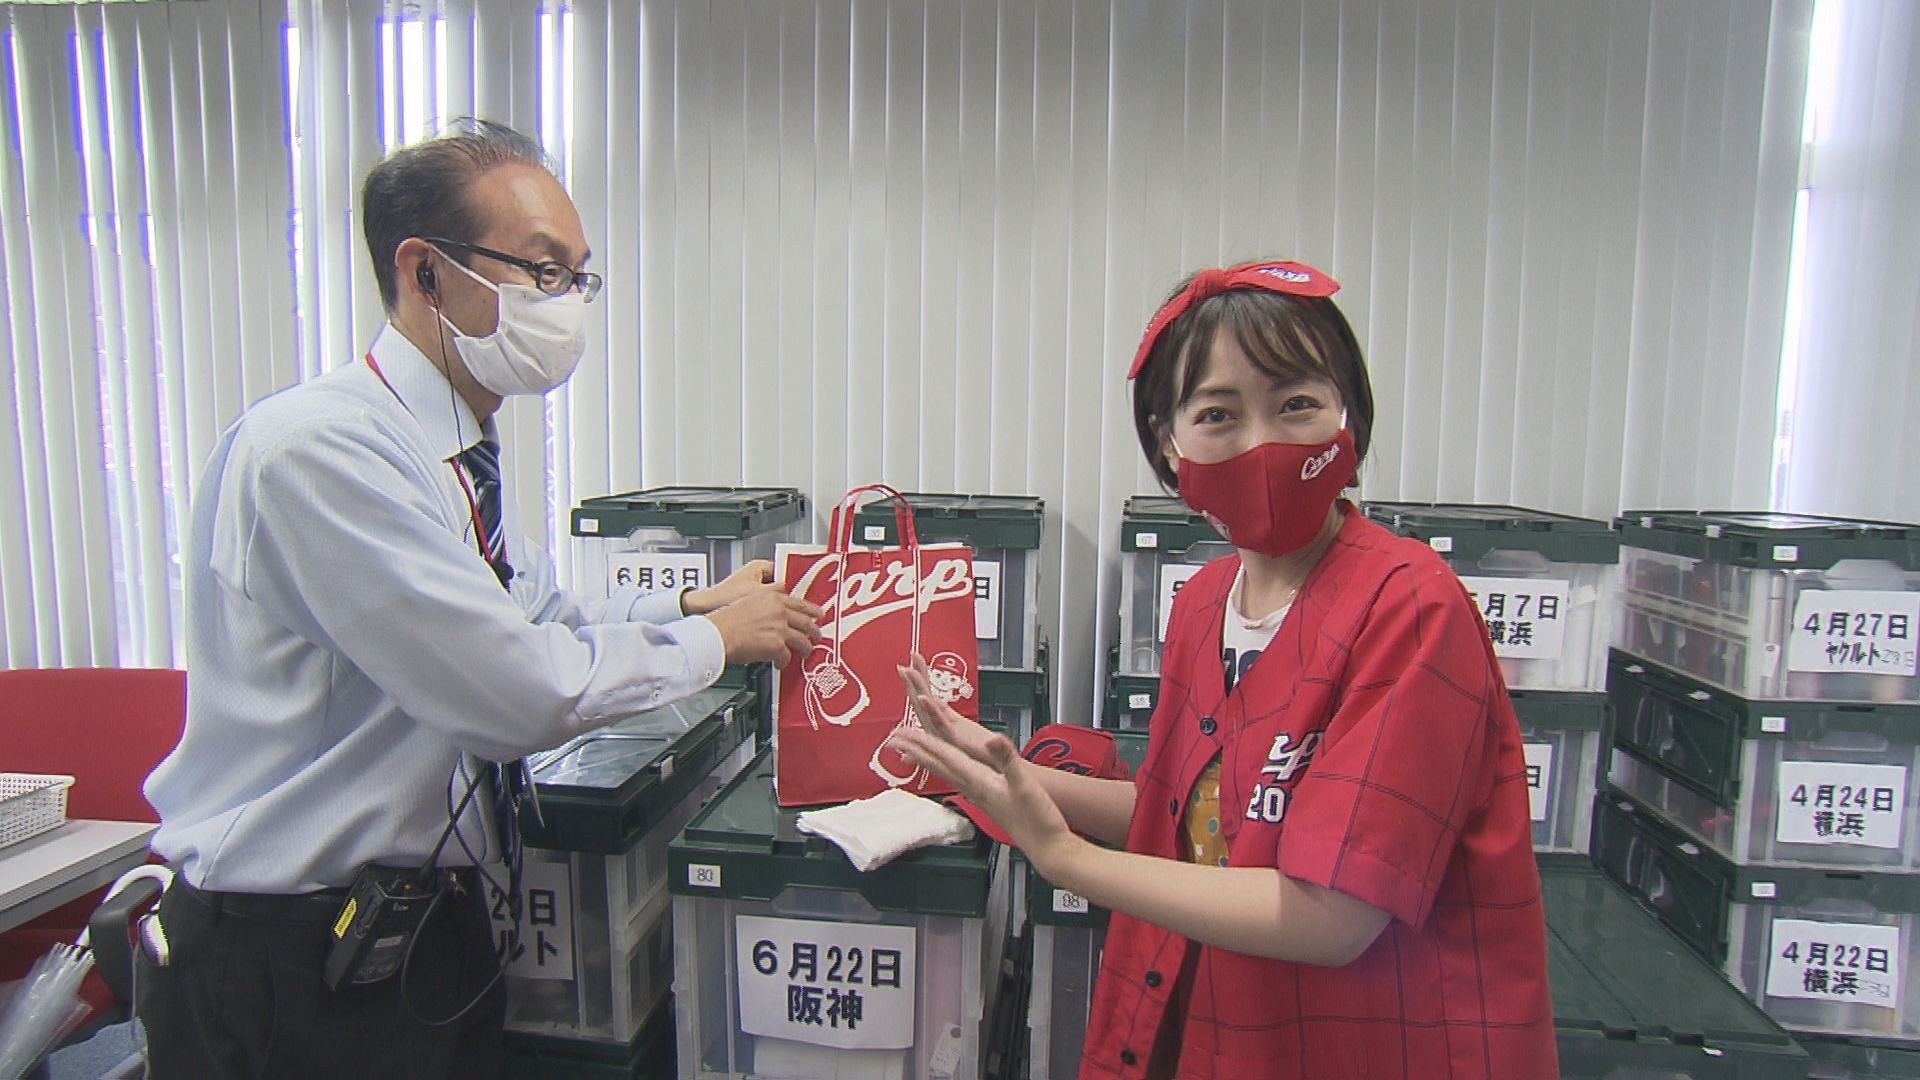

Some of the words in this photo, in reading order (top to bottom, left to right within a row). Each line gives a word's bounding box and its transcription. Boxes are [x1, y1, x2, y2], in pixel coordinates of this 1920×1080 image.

[616, 567, 700, 590] 6月3日
[789, 553, 974, 626] Carp
[1465, 592, 1560, 620] 月7日
[1803, 611, 1909, 640] 4月27日
[1825, 641, 1881, 666] ヤクルト
[1791, 784, 1894, 812] 4月24日
[1814, 811, 1865, 837] 横浜
[752, 939, 902, 988] 6月22日
[1783, 941, 1890, 974] 4月22日
[1803, 967, 1859, 995] 横浜
[787, 983, 864, 1030] 阪神
